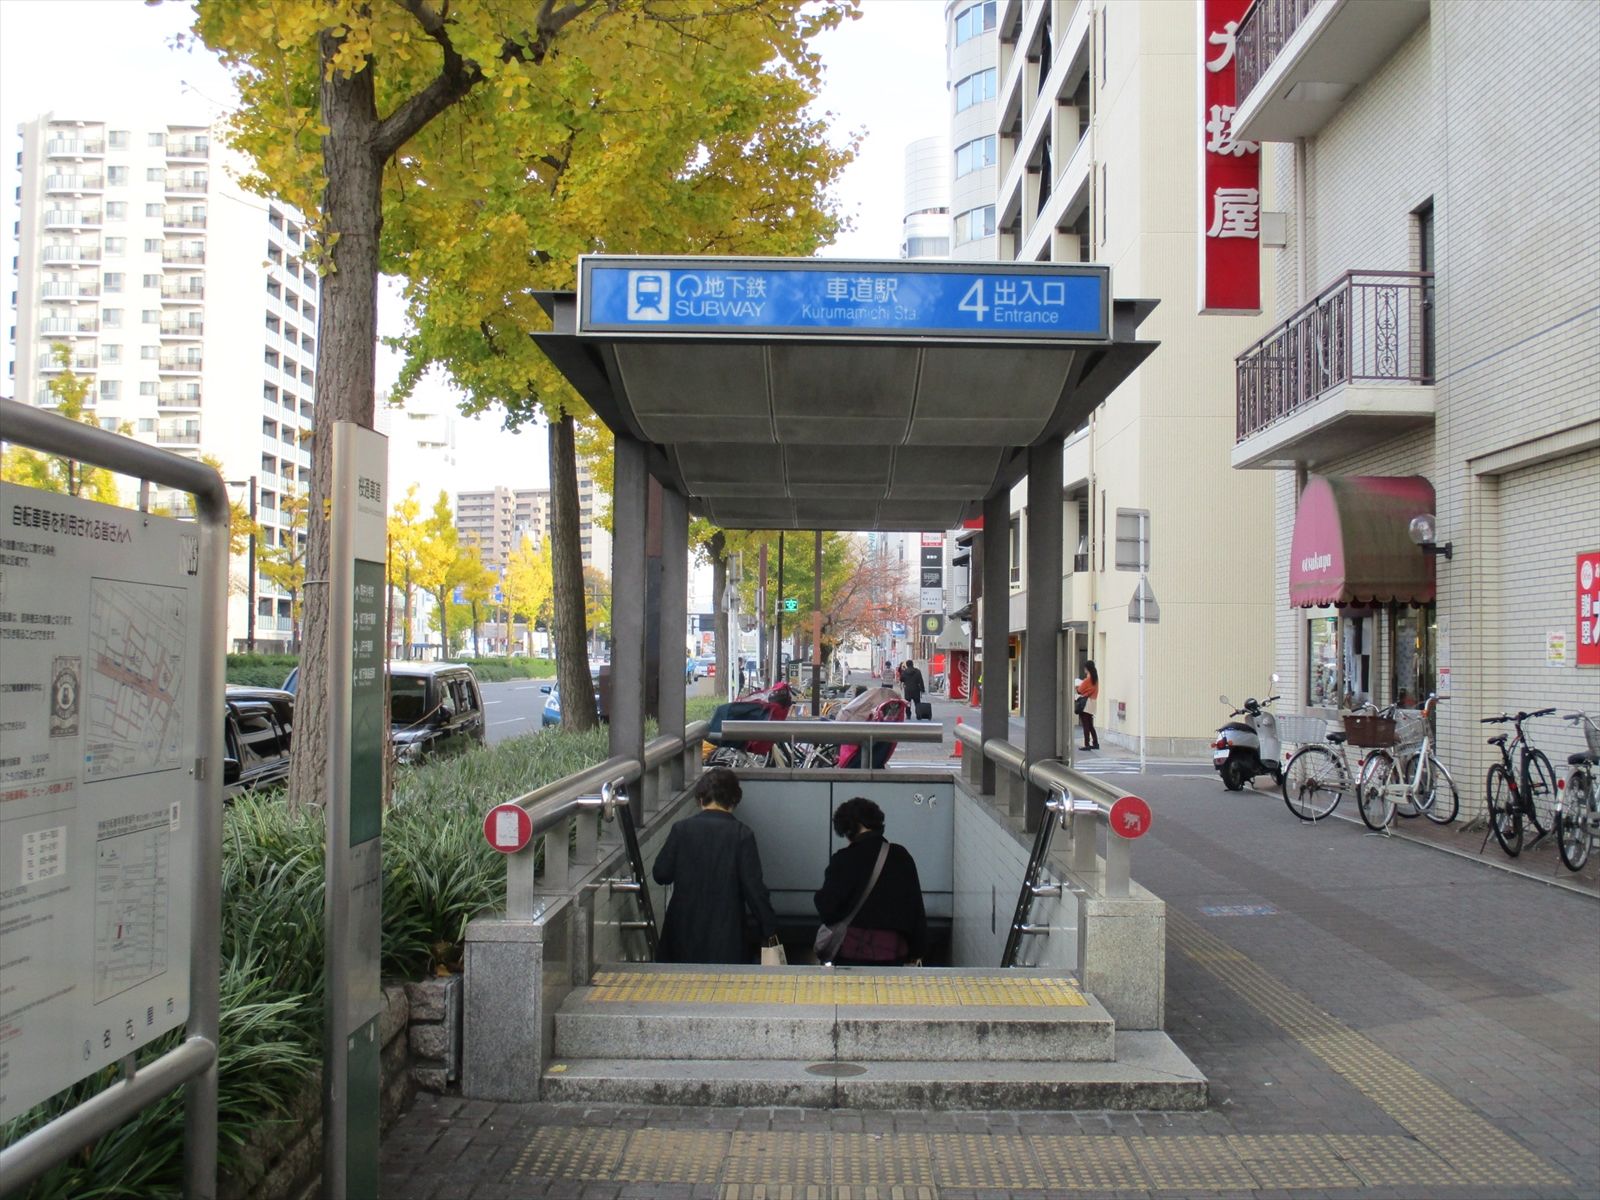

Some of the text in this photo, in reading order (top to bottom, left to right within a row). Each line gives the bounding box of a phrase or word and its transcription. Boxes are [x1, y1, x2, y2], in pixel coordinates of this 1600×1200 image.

[704, 275, 767, 298] 地下鉄
[826, 276, 898, 302] 車道駅
[994, 280, 1065, 306] 出入口
[676, 300, 766, 317] SUBWAY
[802, 304, 890, 320] Kurumamichi
[958, 278, 990, 322] 4
[994, 307, 1059, 323] Entrance
[13, 505, 132, 543] 自転車等を利用される皆さんへ
